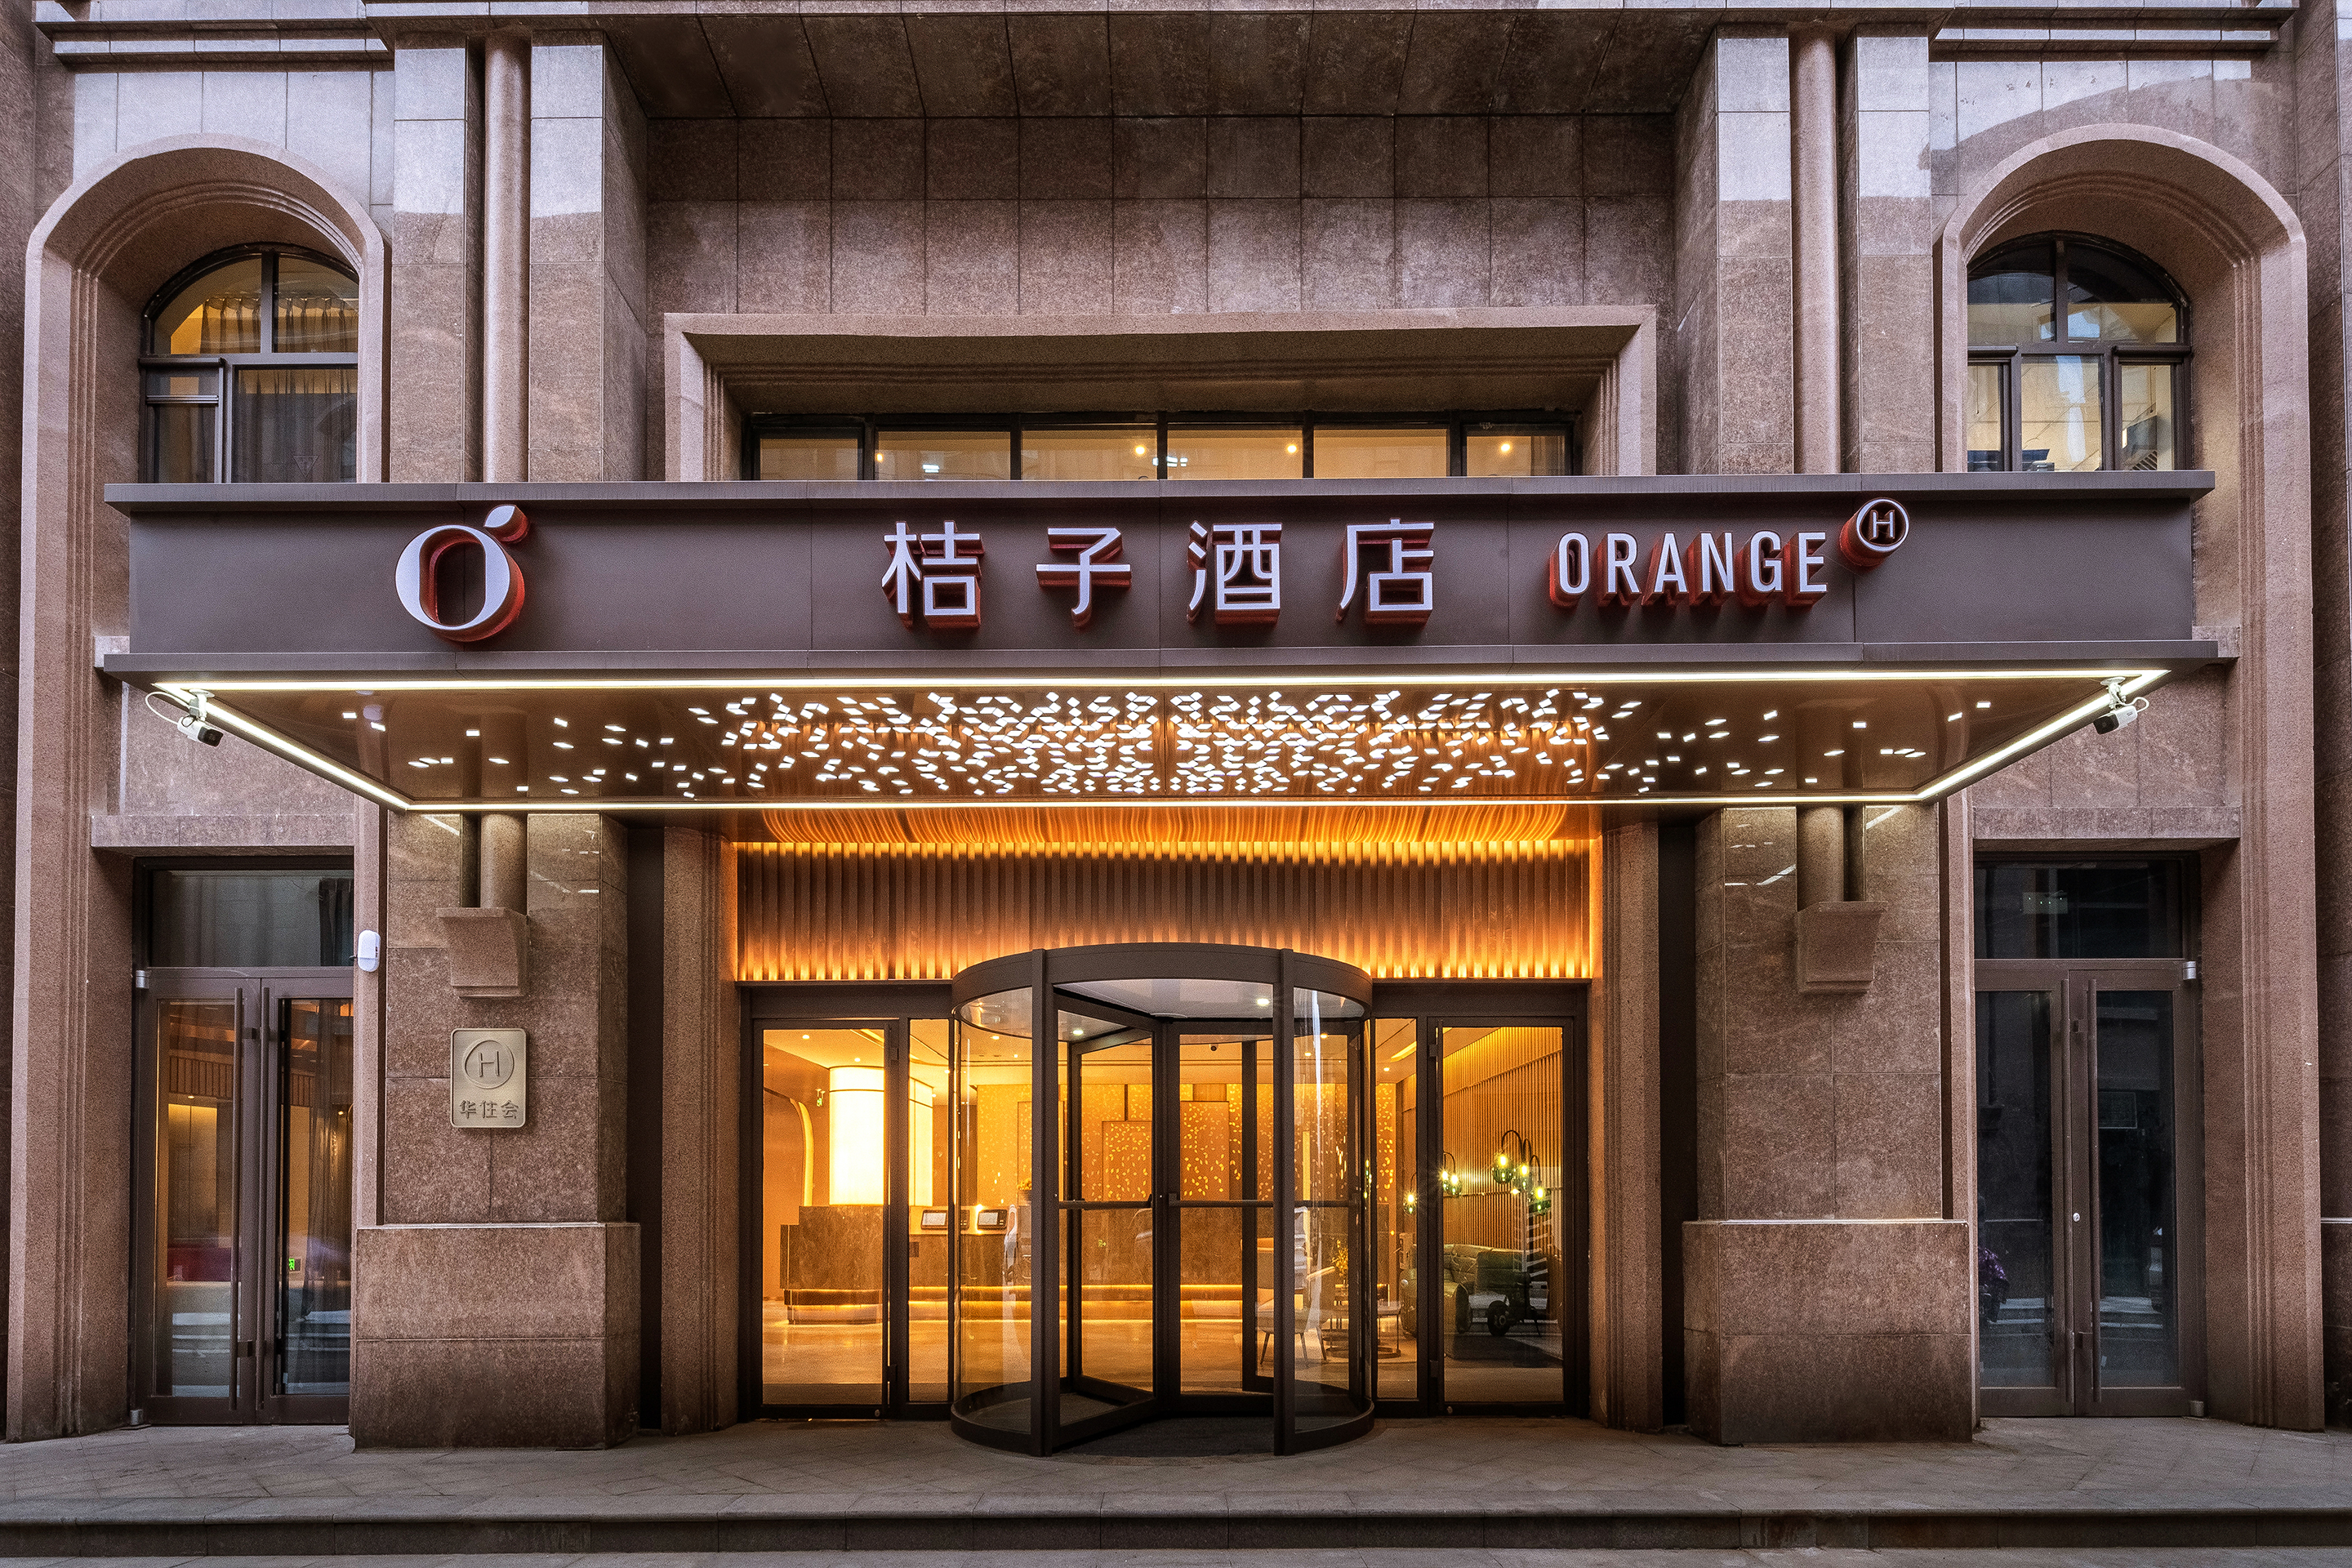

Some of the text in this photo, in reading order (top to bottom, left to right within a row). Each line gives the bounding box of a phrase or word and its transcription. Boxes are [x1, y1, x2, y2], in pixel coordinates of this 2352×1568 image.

[881, 519, 1435, 616] 桔子酒店
[1558, 531, 1828, 595] ORANGE
[458, 1099, 519, 1120] 华住会
